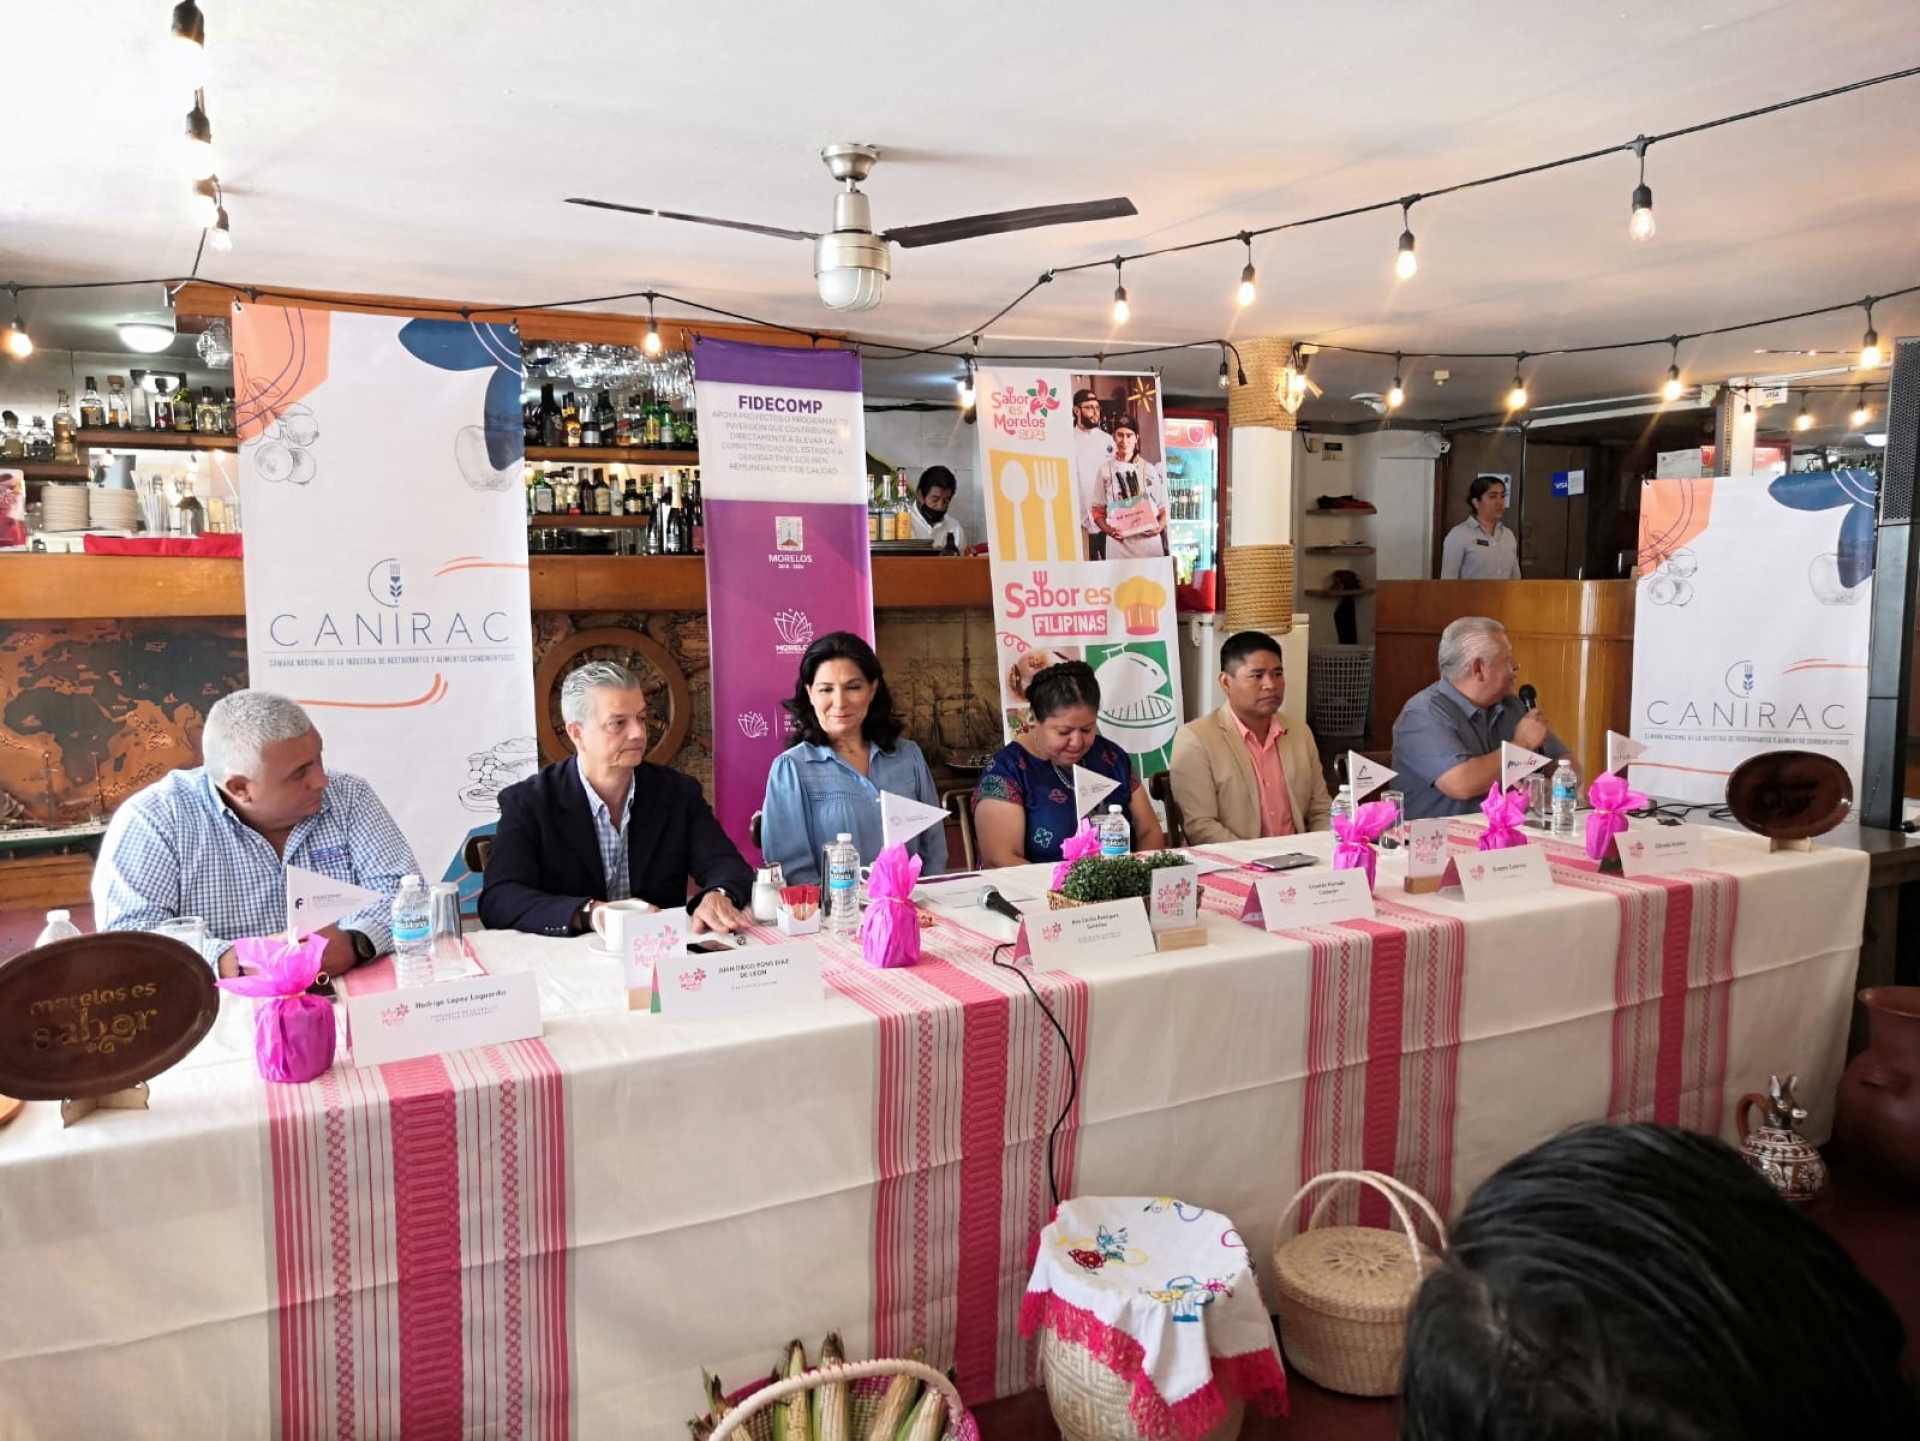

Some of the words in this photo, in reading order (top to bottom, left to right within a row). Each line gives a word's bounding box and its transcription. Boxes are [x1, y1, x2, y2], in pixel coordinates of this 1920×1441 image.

[738, 395, 823, 413] FIDECOMP
[991, 385, 1029, 409] Sabor
[993, 411, 1046, 435] Morelos
[769, 554, 813, 563] MORELOS
[1005, 570, 1080, 619] Sabor
[1084, 587, 1112, 606] es
[269, 611, 509, 646] CANIRAC
[1034, 614, 1107, 635] FILIPINAS
[1646, 700, 1846, 730] CANIRAC
[130, 981, 158, 999] es
